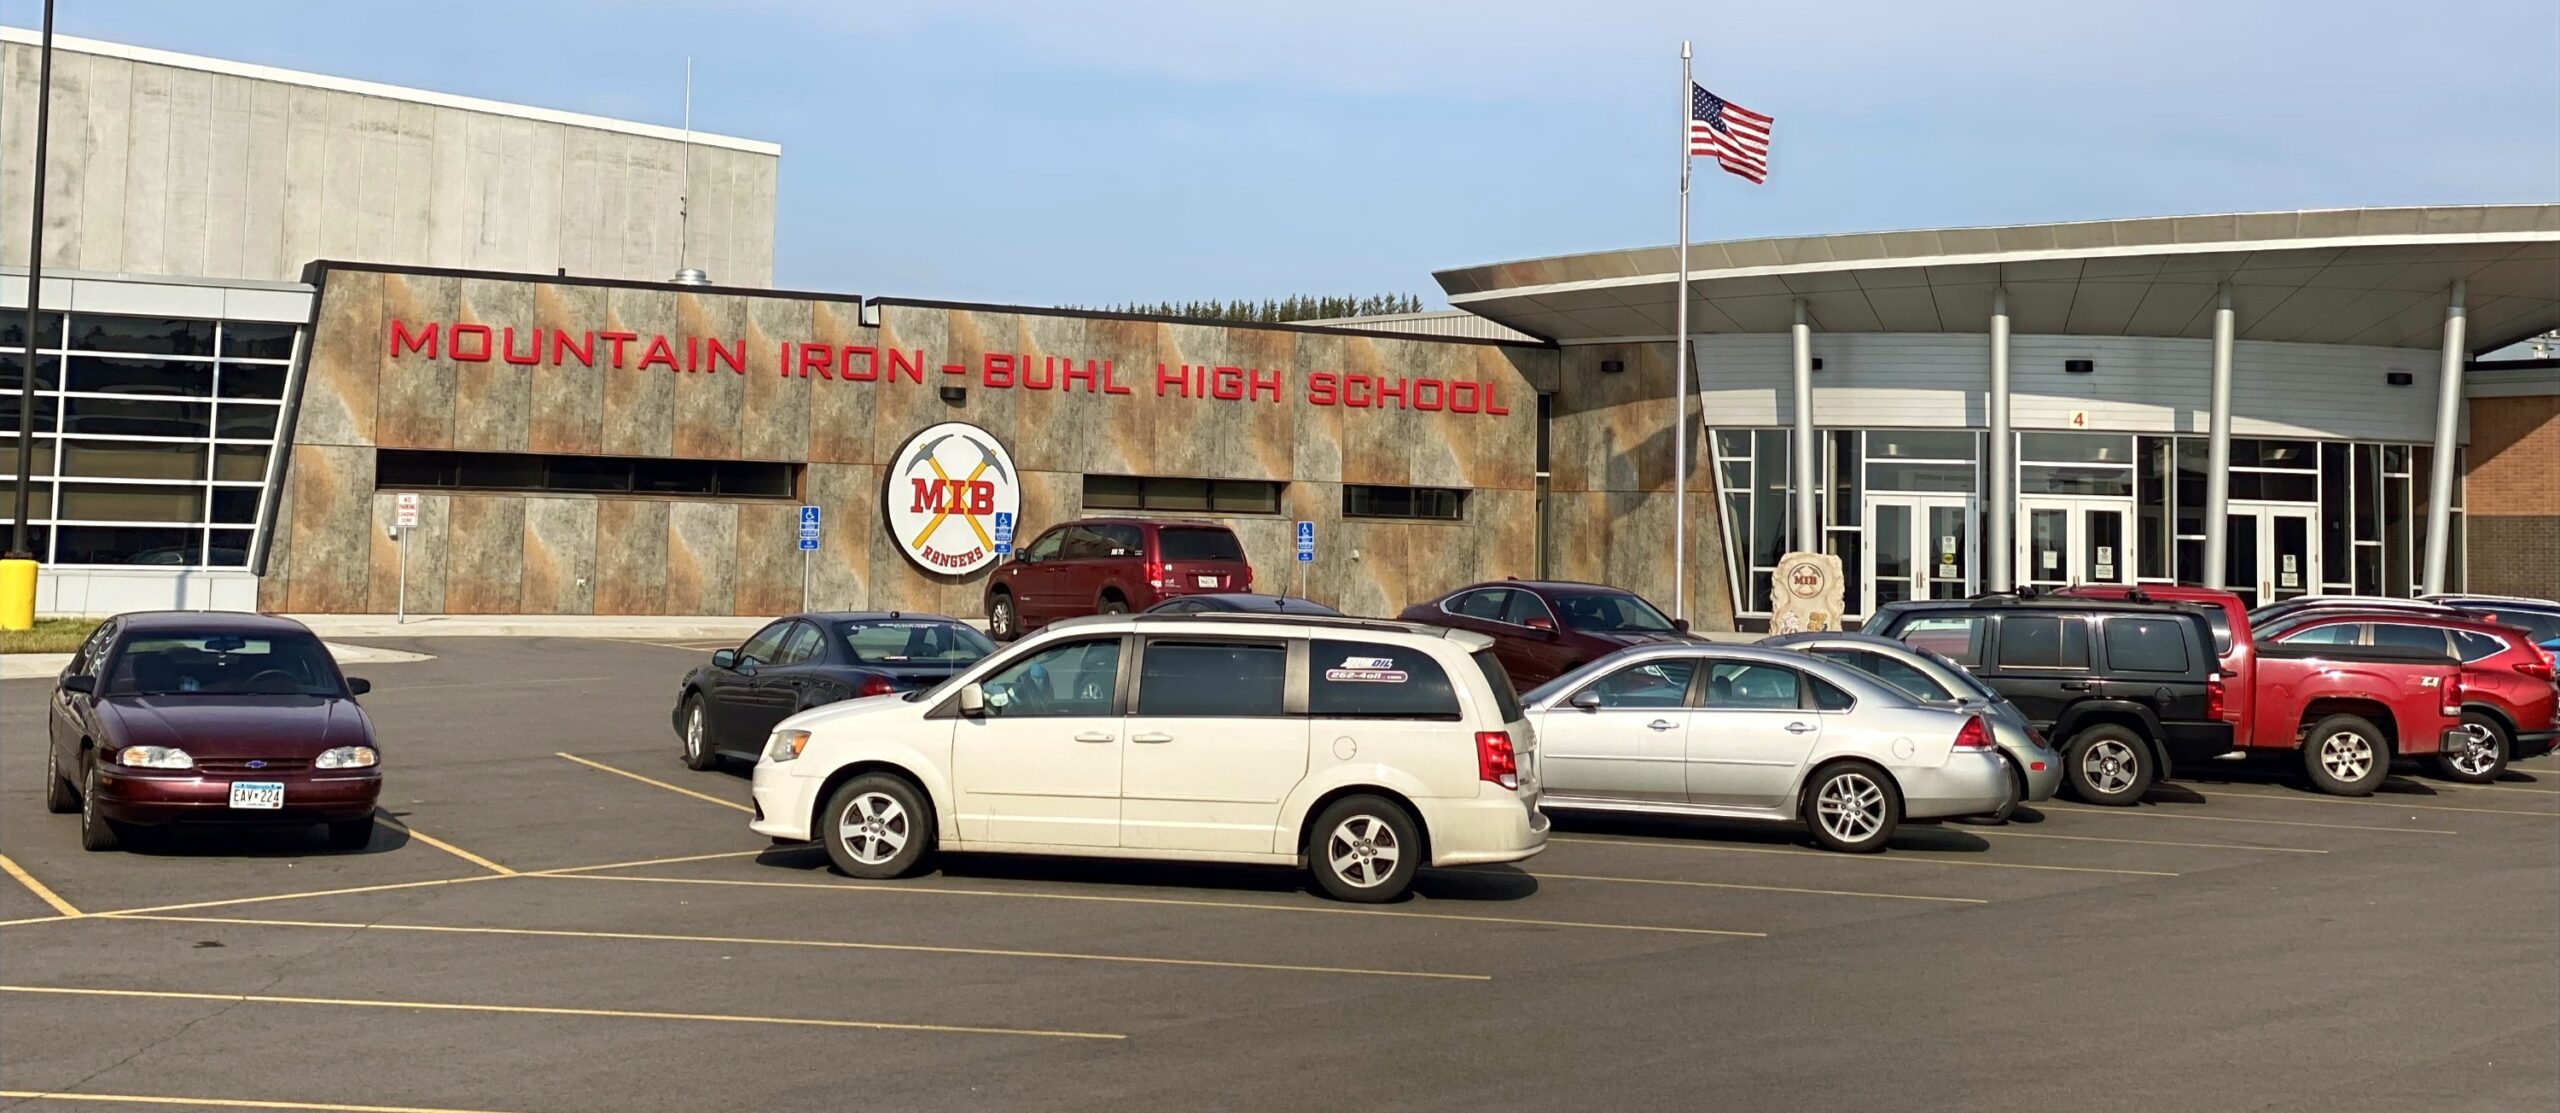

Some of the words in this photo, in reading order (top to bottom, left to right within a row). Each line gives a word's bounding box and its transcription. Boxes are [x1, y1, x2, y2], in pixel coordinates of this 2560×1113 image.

[388, 317, 748, 375] MOUNTAIN
[779, 340, 925, 385] IRON
[981, 351, 1132, 395] BUHL
[1155, 361, 1283, 403] HIGH
[1307, 370, 1511, 416] SCHOOL
[2073, 412, 2085, 427] 4
[910, 477, 995, 516] MIB
[921, 545, 984, 568] RANGERS
[1793, 575, 1818, 586] MIB
